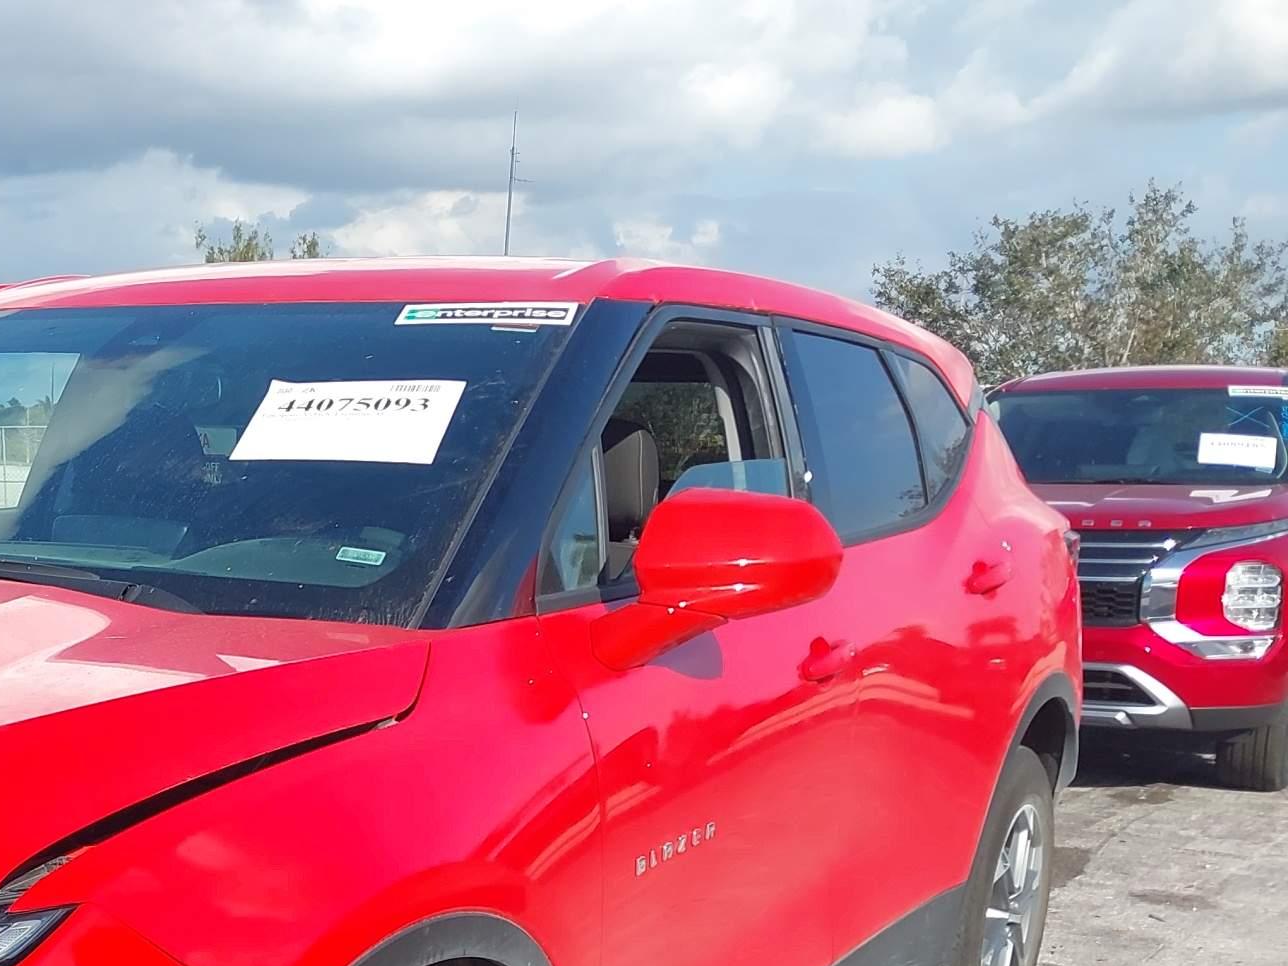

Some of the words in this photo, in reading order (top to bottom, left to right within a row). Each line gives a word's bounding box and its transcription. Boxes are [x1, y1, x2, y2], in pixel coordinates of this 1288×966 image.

[415, 308, 568, 320] enterprise
[277, 397, 431, 413] 44075093
[634, 821, 717, 877] BLAZER
